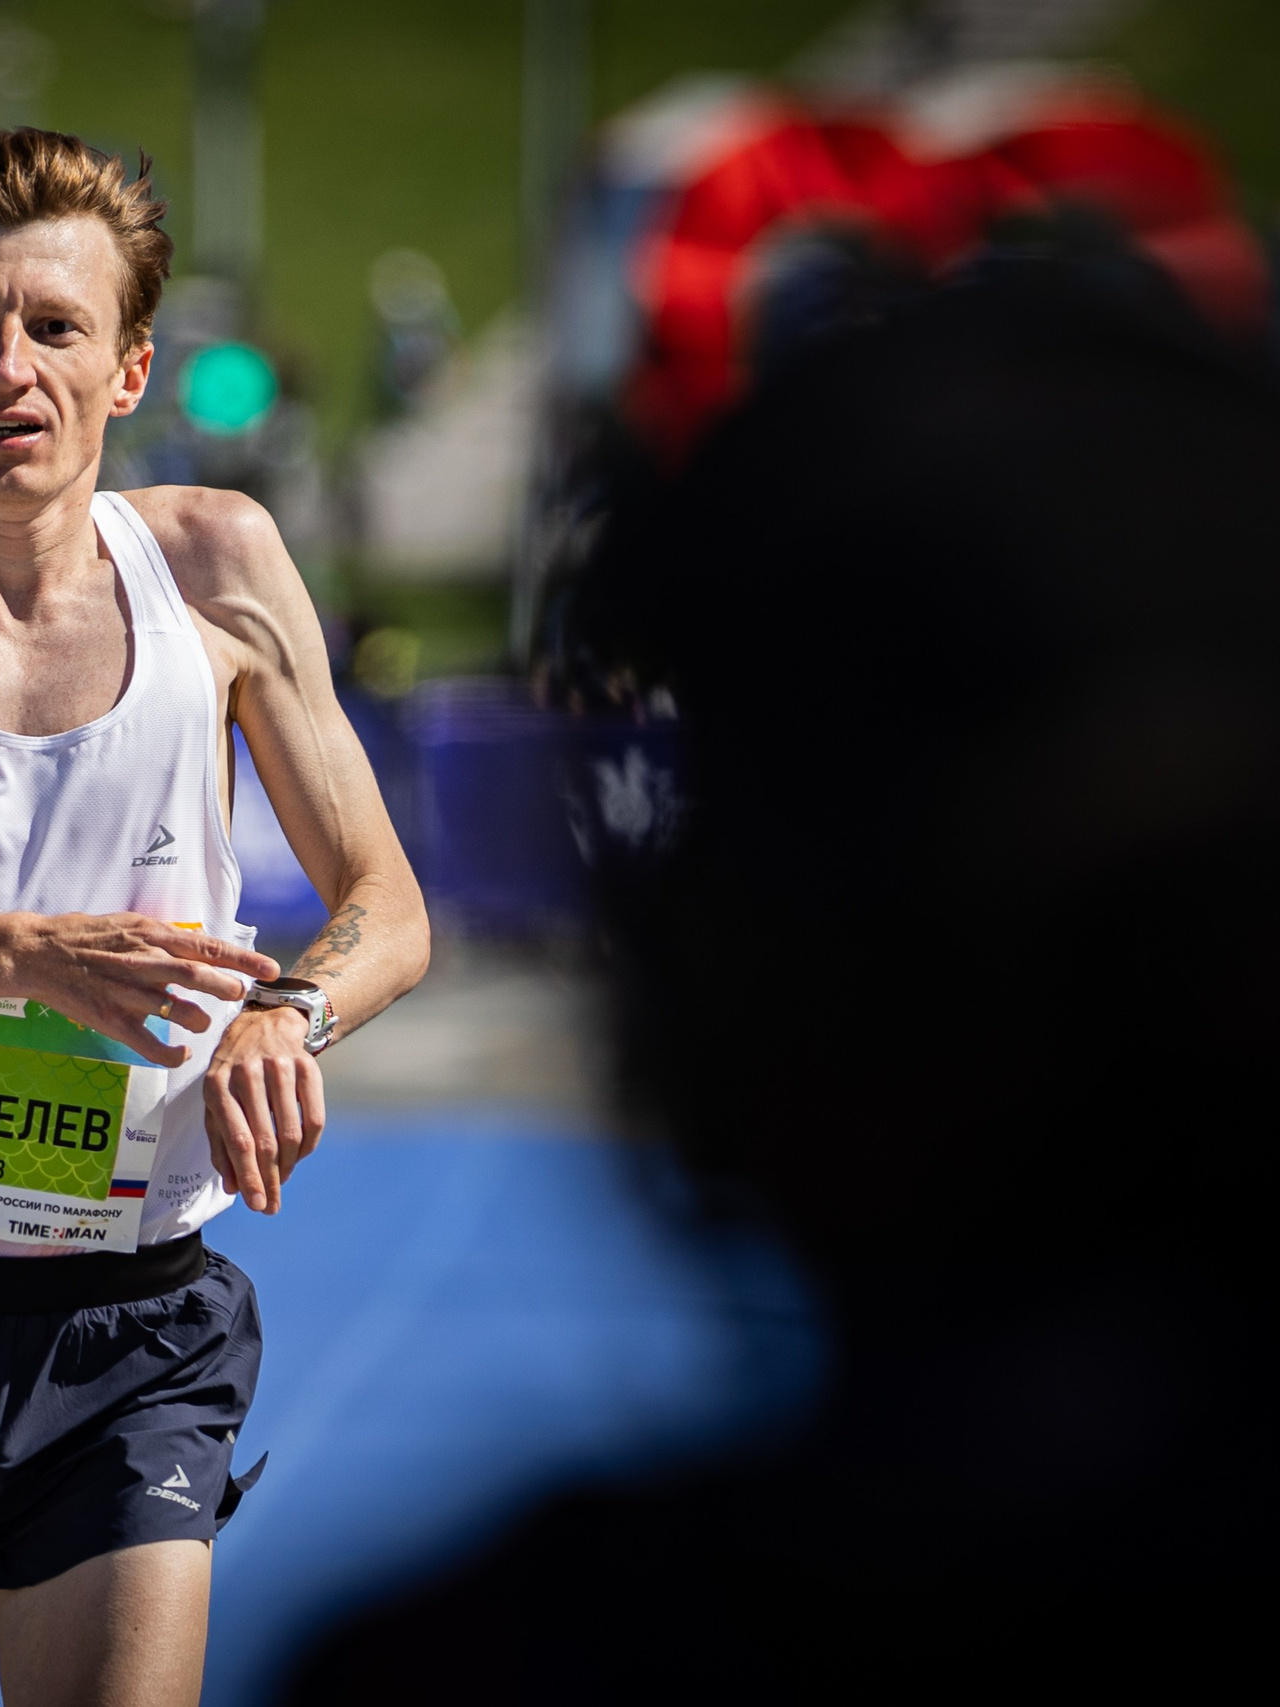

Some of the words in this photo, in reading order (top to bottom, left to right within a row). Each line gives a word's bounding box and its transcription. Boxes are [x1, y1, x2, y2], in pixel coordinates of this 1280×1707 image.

[168, 1172, 202, 1185] DEMIX
[170, 1199, 194, 1208] TEC
[43, 1203, 61, 1214] ПО
[63, 1206, 123, 1219] МАРАФОНУ
[146, 1486, 201, 1511] DEMIX
